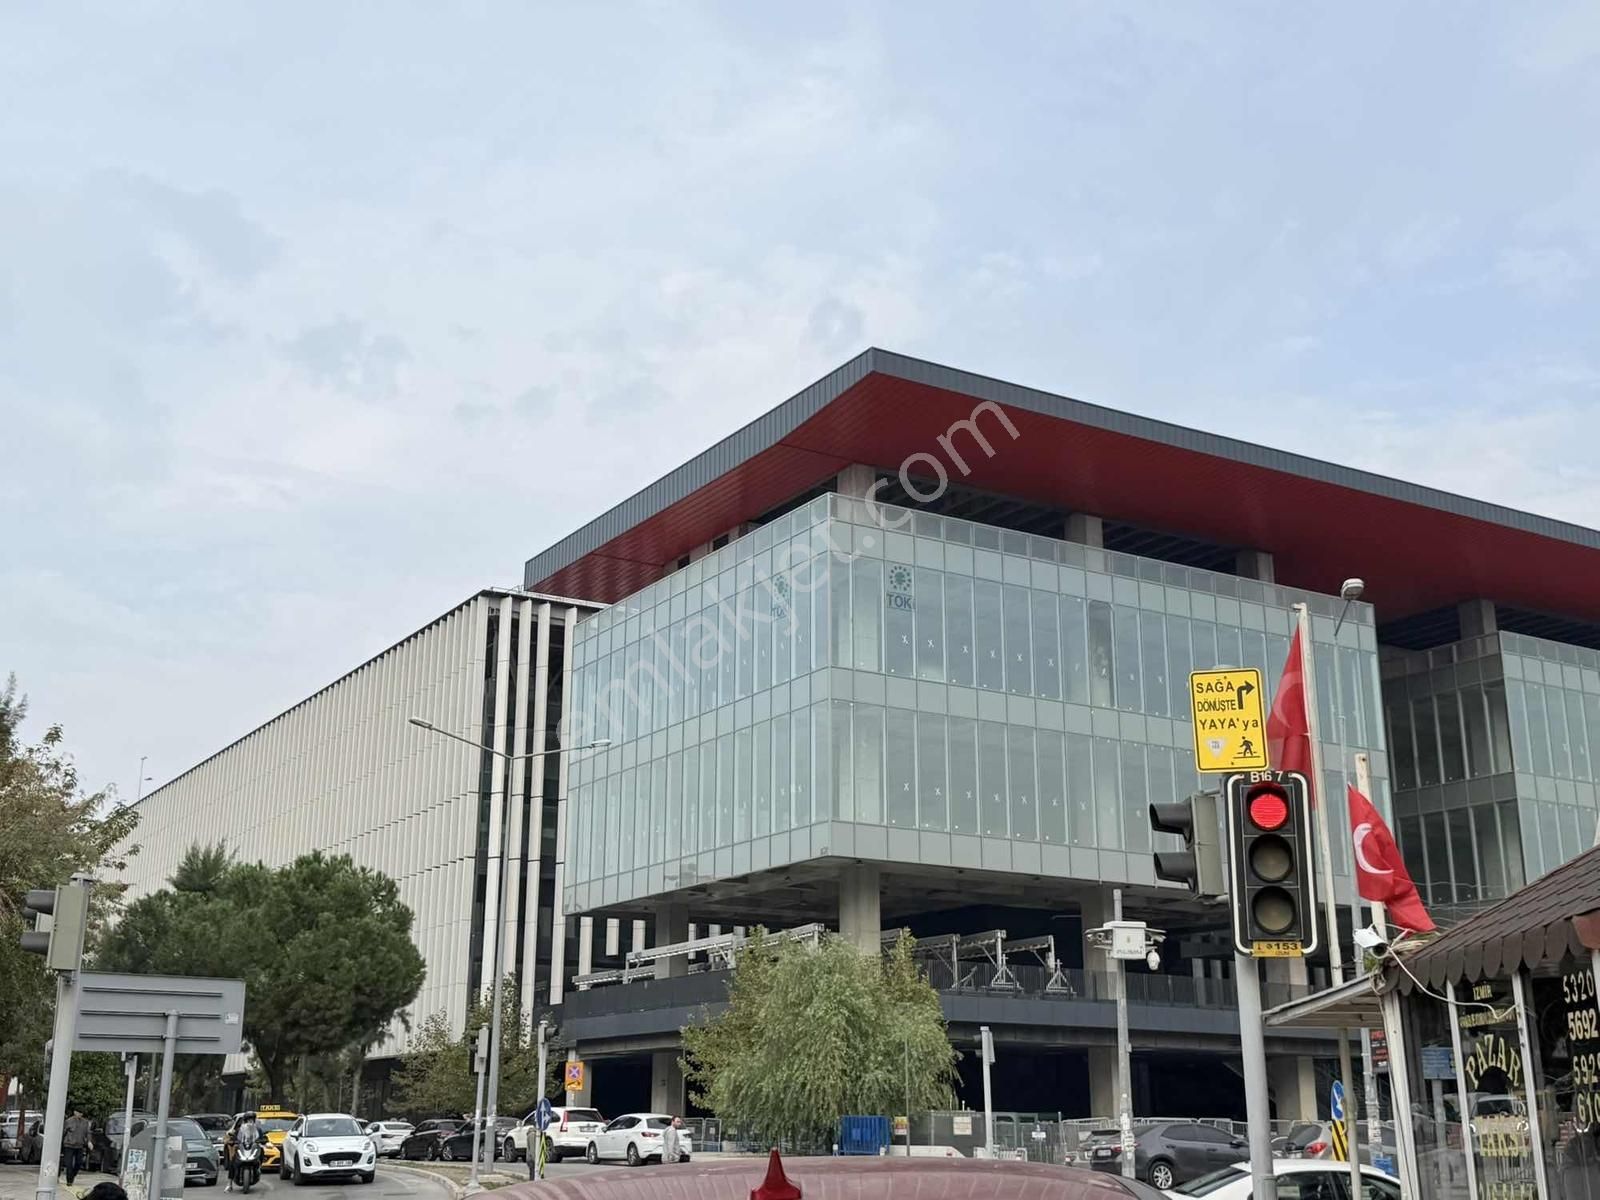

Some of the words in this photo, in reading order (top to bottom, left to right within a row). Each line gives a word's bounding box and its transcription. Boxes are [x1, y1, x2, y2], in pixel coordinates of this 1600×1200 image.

[1196, 679, 1235, 694] SAĞA
[1197, 698, 1236, 712] DÖNÜŞTE
[1562, 968, 1595, 1004] 5320
[1567, 1008, 1599, 1041] 5692
[1465, 1033, 1521, 1090] PAZAR
